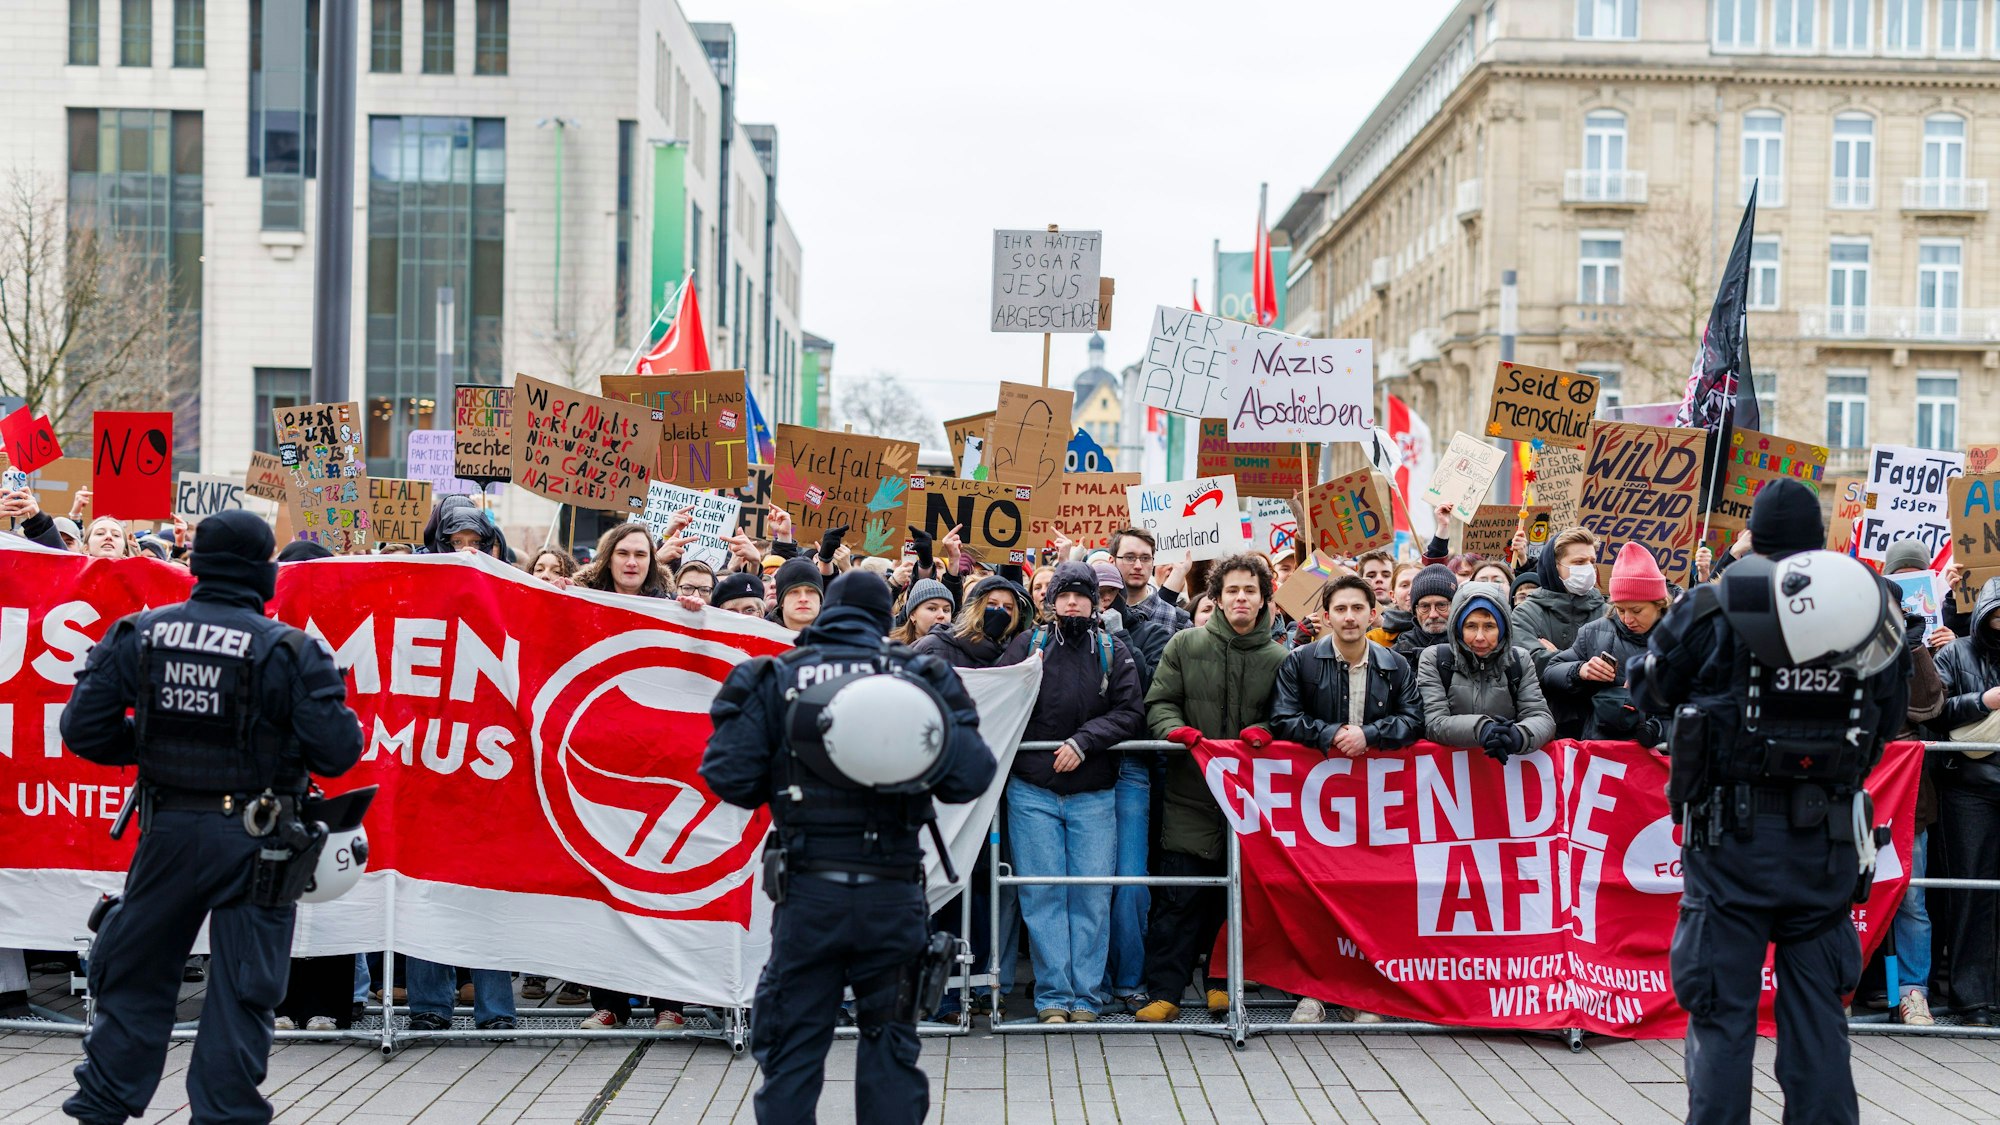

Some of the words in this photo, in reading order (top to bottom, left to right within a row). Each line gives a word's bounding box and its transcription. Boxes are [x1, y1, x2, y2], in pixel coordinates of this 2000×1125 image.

[1003, 235, 1032, 249] IHR
[1044, 232, 1097, 252] HÄTTET
[1012, 253, 1080, 270] SOGAR
[1002, 273, 1080, 298] JESUS
[994, 299, 1109, 330] ABGESCHOBEN
[1160, 310, 1223, 346] WER
[1148, 337, 1227, 380] EIGE
[1252, 342, 1334, 378] NAZIS
[456, 388, 514, 408] MENSCHEN
[1233, 385, 1372, 431] Abschieben
[457, 407, 513, 428] RECHTE
[526, 383, 580, 420] Wer
[581, 405, 639, 438] Nichts
[472, 427, 496, 437] statt
[527, 410, 567, 434] Denkt
[663, 421, 709, 441] bleibt
[304, 424, 350, 445] UNS
[411, 434, 430, 444] WER
[432, 434, 448, 445] MIT
[95, 428, 168, 477] NO
[411, 448, 454, 461] PAKTIERT
[456, 438, 511, 456] rechte
[525, 446, 550, 466] Den
[409, 463, 425, 474] HAT
[455, 459, 510, 477] Menschen
[656, 439, 746, 484] UNT
[790, 440, 885, 484] Vielfalt
[1202, 456, 1228, 468] WIE
[1234, 457, 1270, 469] DUMM
[1549, 456, 1560, 467] ES
[1561, 453, 1580, 465] DER
[259, 471, 285, 487] MAL
[940, 478, 980, 491] ALICE
[1241, 471, 1267, 483] DIE
[1536, 482, 1555, 493] DER
[1556, 478, 1573, 488] DIR
[1623, 481, 1648, 489] UND
[369, 479, 430, 501] ELFALT
[1076, 482, 1107, 495] MAL
[1187, 479, 1219, 503] zurück
[1538, 490, 1569, 502] ANGST
[372, 500, 420, 517] tatt
[649, 486, 662, 497] AN
[664, 488, 701, 507] MÖCHTE
[703, 498, 736, 515] DURCH
[1140, 491, 1172, 513] Alice
[1309, 486, 1372, 529] FCK
[1580, 484, 1694, 519] WÜTEND
[1838, 503, 1861, 519] WIR
[1890, 496, 1937, 513] gegen
[695, 508, 726, 523] GEHEN
[925, 491, 1023, 548] NO
[1258, 507, 1279, 518] dann
[372, 519, 422, 541] NFALT
[653, 512, 669, 524] DIE
[703, 522, 722, 535] MIT
[1054, 520, 1103, 535] PLATZ
[1143, 518, 1157, 530] ins
[1319, 510, 1381, 551] AFD
[1466, 529, 1511, 539] ANTWORT
[1579, 514, 1680, 543] GEGEN
[1483, 541, 1501, 550] WAR
[152, 622, 252, 659] POLIZEI
[164, 661, 222, 688] NRW
[1775, 667, 1841, 692] 31252
[161, 687, 220, 714] 31251
[1205, 750, 1476, 847] GEGEN
[1503, 745, 1628, 850] DIE
[1374, 956, 1501, 983] SCHWEIGEN
[1586, 961, 1667, 993] SCHAUEN
[1489, 988, 1540, 1018] WIR
[1545, 978, 1644, 1025] HANDELN!
